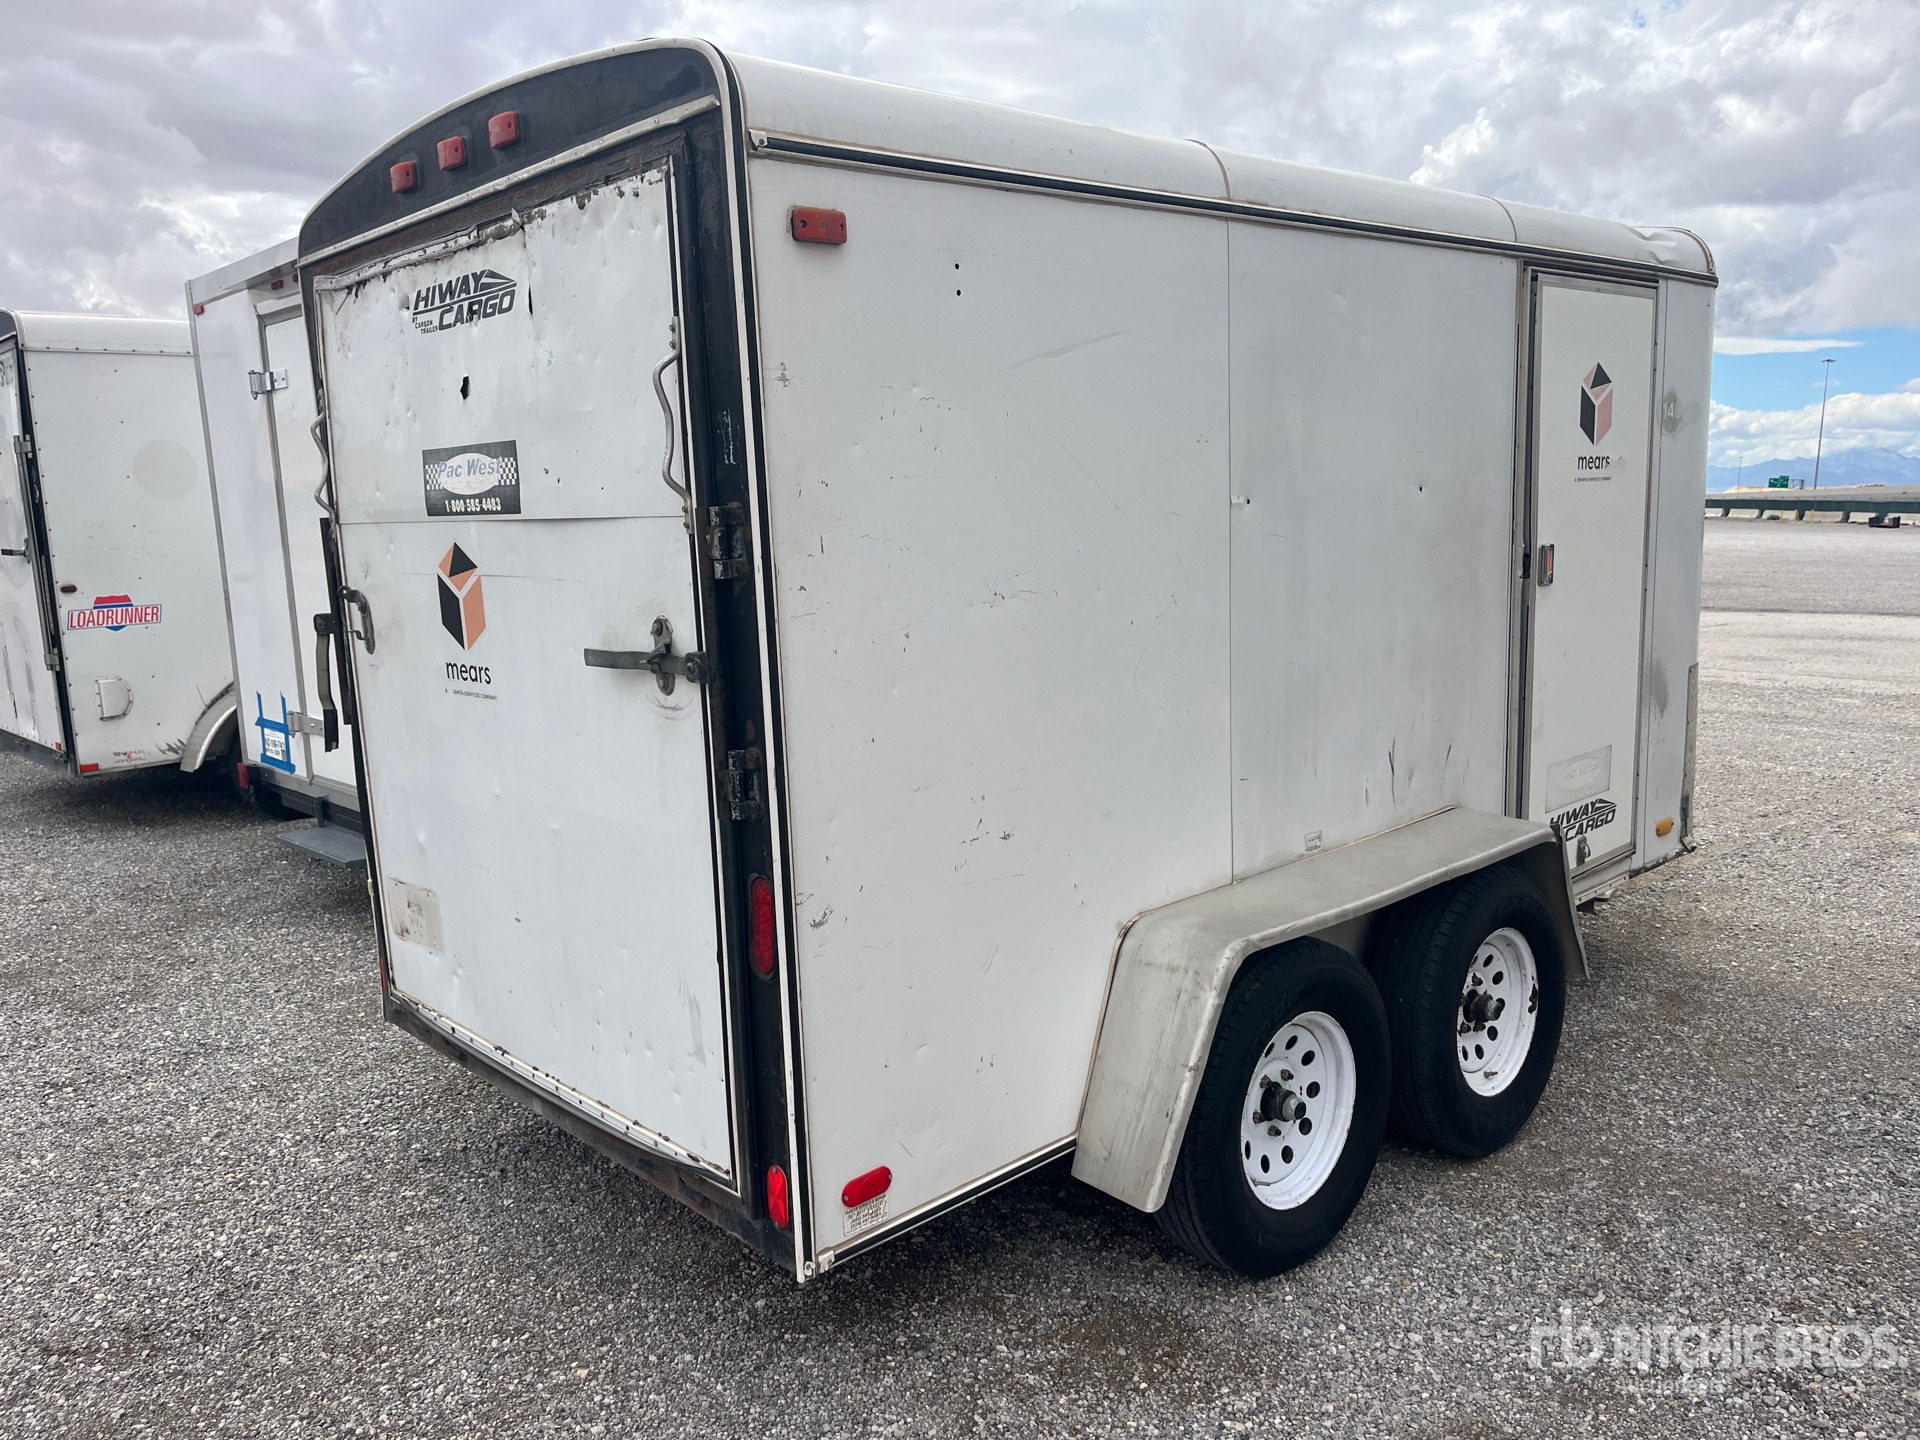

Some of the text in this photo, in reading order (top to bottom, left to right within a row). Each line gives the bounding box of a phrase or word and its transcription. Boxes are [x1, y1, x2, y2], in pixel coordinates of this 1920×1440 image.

[413, 269, 488, 311] HIWAY
[438, 289, 516, 331] CARGO
[415, 320, 433, 329] CARSON
[420, 326, 438, 335] TRAILER
[437, 457, 502, 478] Pac West
[1577, 455, 1610, 470] mears
[69, 605, 160, 629] LOADRUNNER
[445, 662, 492, 685] mears
[1549, 798, 1600, 827] HIWAY
[1565, 808, 1616, 842] CARGO
